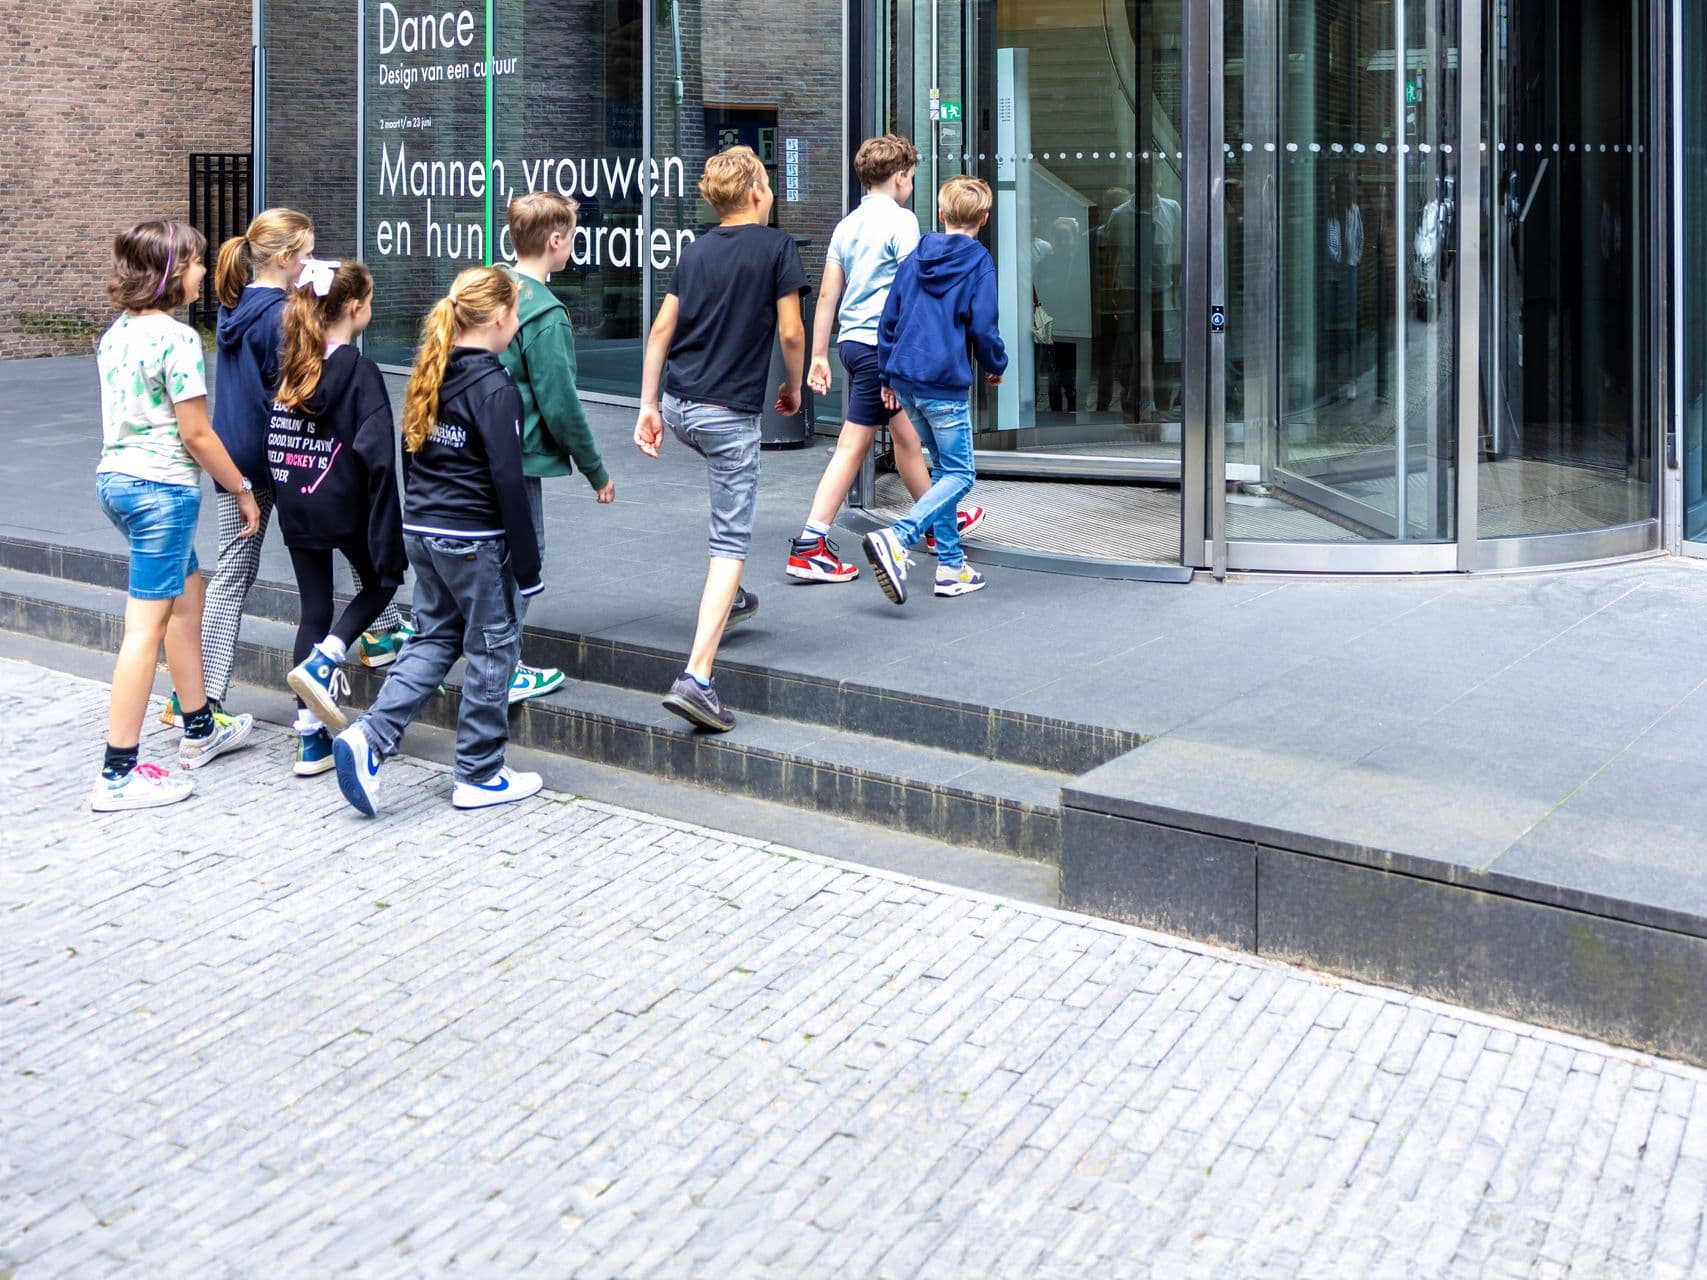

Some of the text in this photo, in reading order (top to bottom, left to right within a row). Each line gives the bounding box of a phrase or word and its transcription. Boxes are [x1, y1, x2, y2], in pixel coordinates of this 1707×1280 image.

[379, 2, 474, 55] Dance
[379, 56, 518, 90] Design van een cutuur
[380, 119, 384, 129] 2
[384, 119, 401, 129] maart
[413, 117, 420, 128] 23
[421, 116, 432, 130] juni
[378, 140, 684, 207] Mannen, vrouwen
[376, 198, 696, 276] en hun aaraten
[307, 421, 316, 434] IS
[285, 453, 317, 469] HOCKEY
[318, 456, 328, 470] IS
